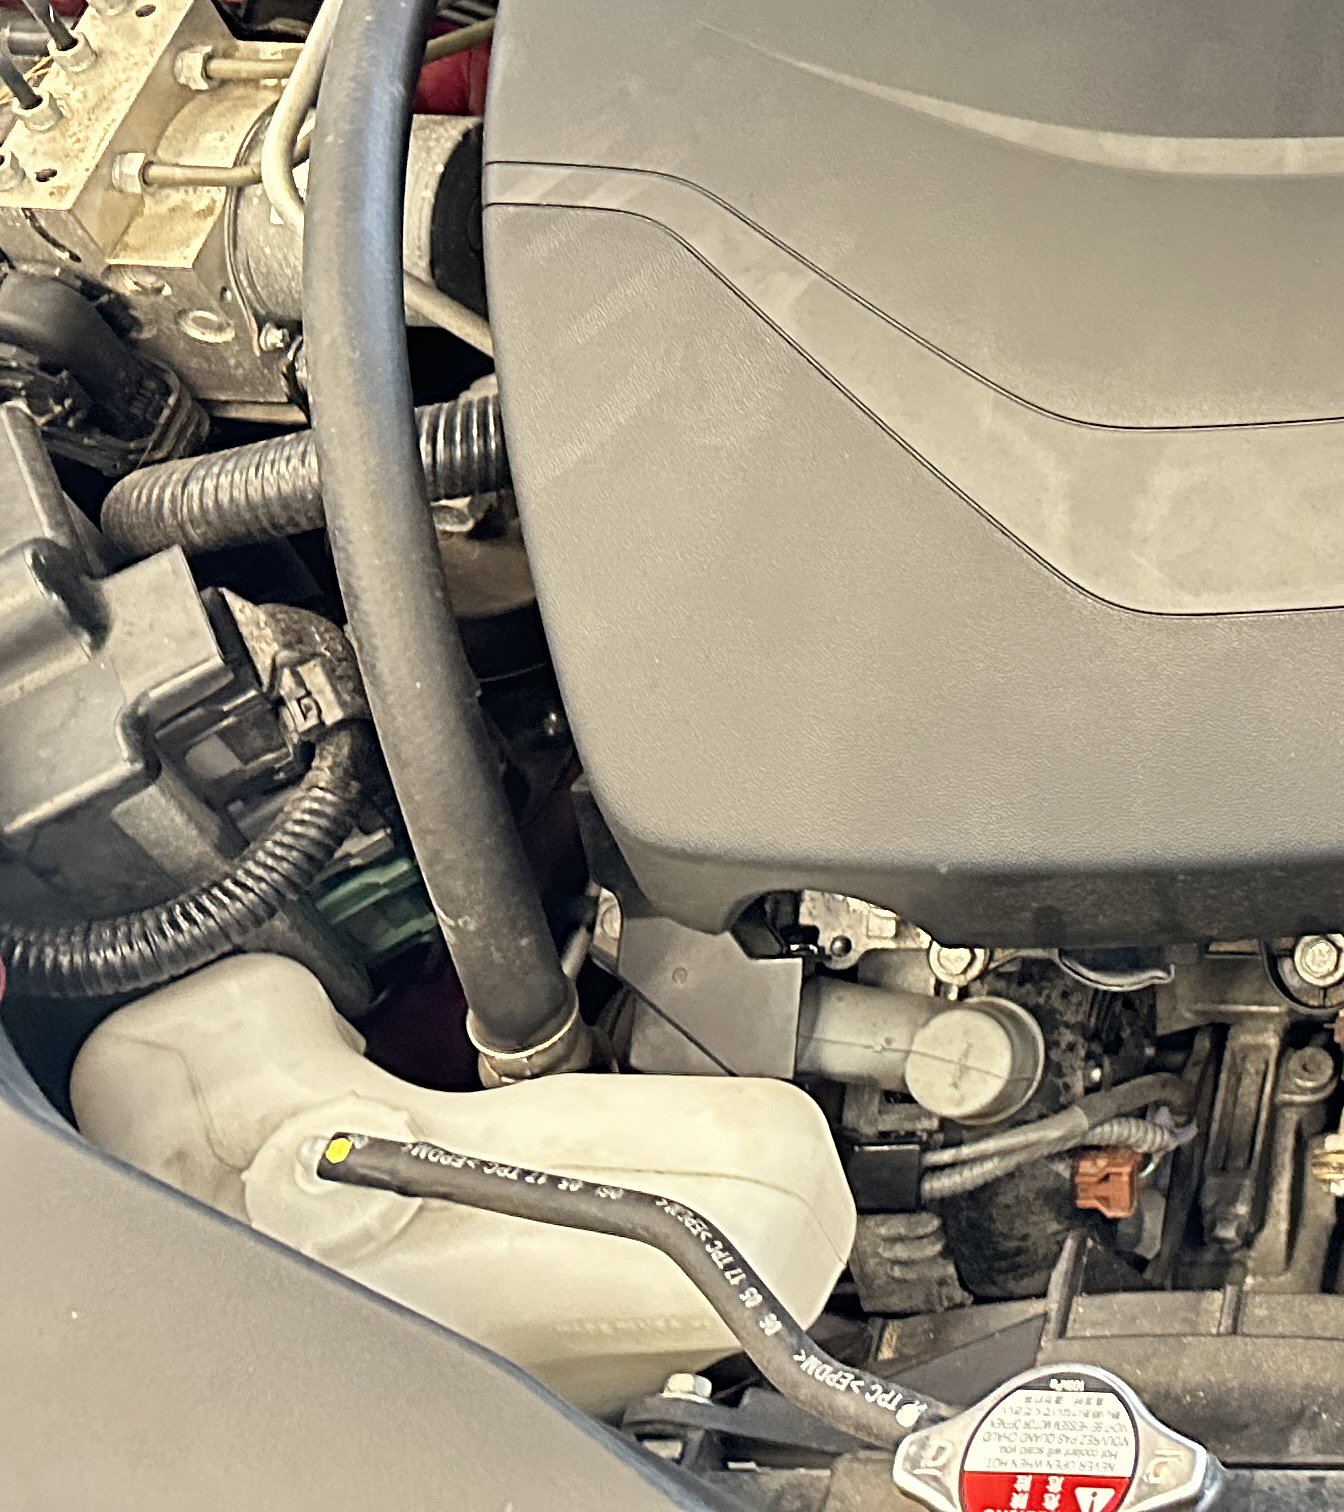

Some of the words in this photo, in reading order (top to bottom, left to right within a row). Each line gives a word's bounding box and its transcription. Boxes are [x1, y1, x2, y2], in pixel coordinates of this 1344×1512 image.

[792, 1348, 865, 1395] >EPDM<
[864, 1383, 903, 1412] TPC
[1047, 1459, 1077, 1472] OPEN
[1078, 1459, 1116, 1472] NEVER
